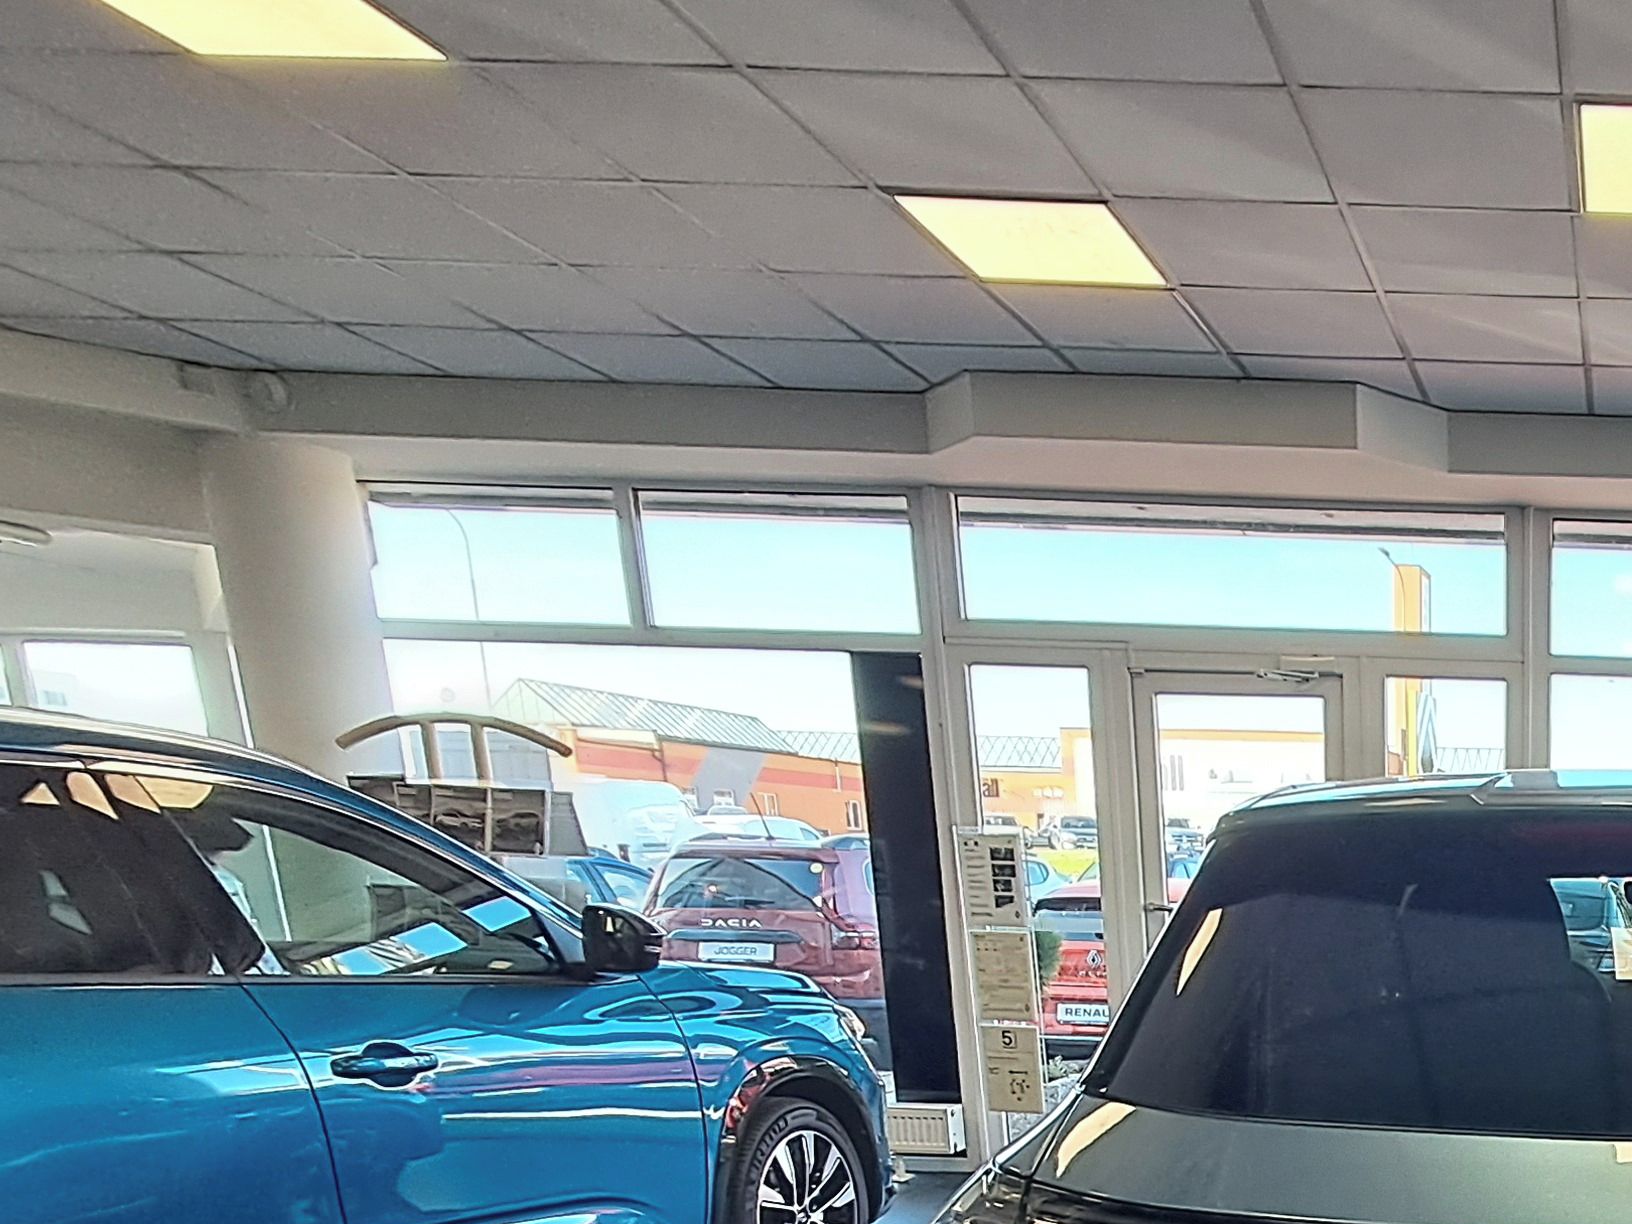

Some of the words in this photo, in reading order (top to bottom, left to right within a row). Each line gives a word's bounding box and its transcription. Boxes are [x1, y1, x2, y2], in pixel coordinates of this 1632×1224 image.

[700, 918, 763, 928] DACIA
[713, 946, 758, 956] JOGGER
[1064, 1007, 1110, 1018] RENAU
[1001, 1030, 1013, 1046] 5
